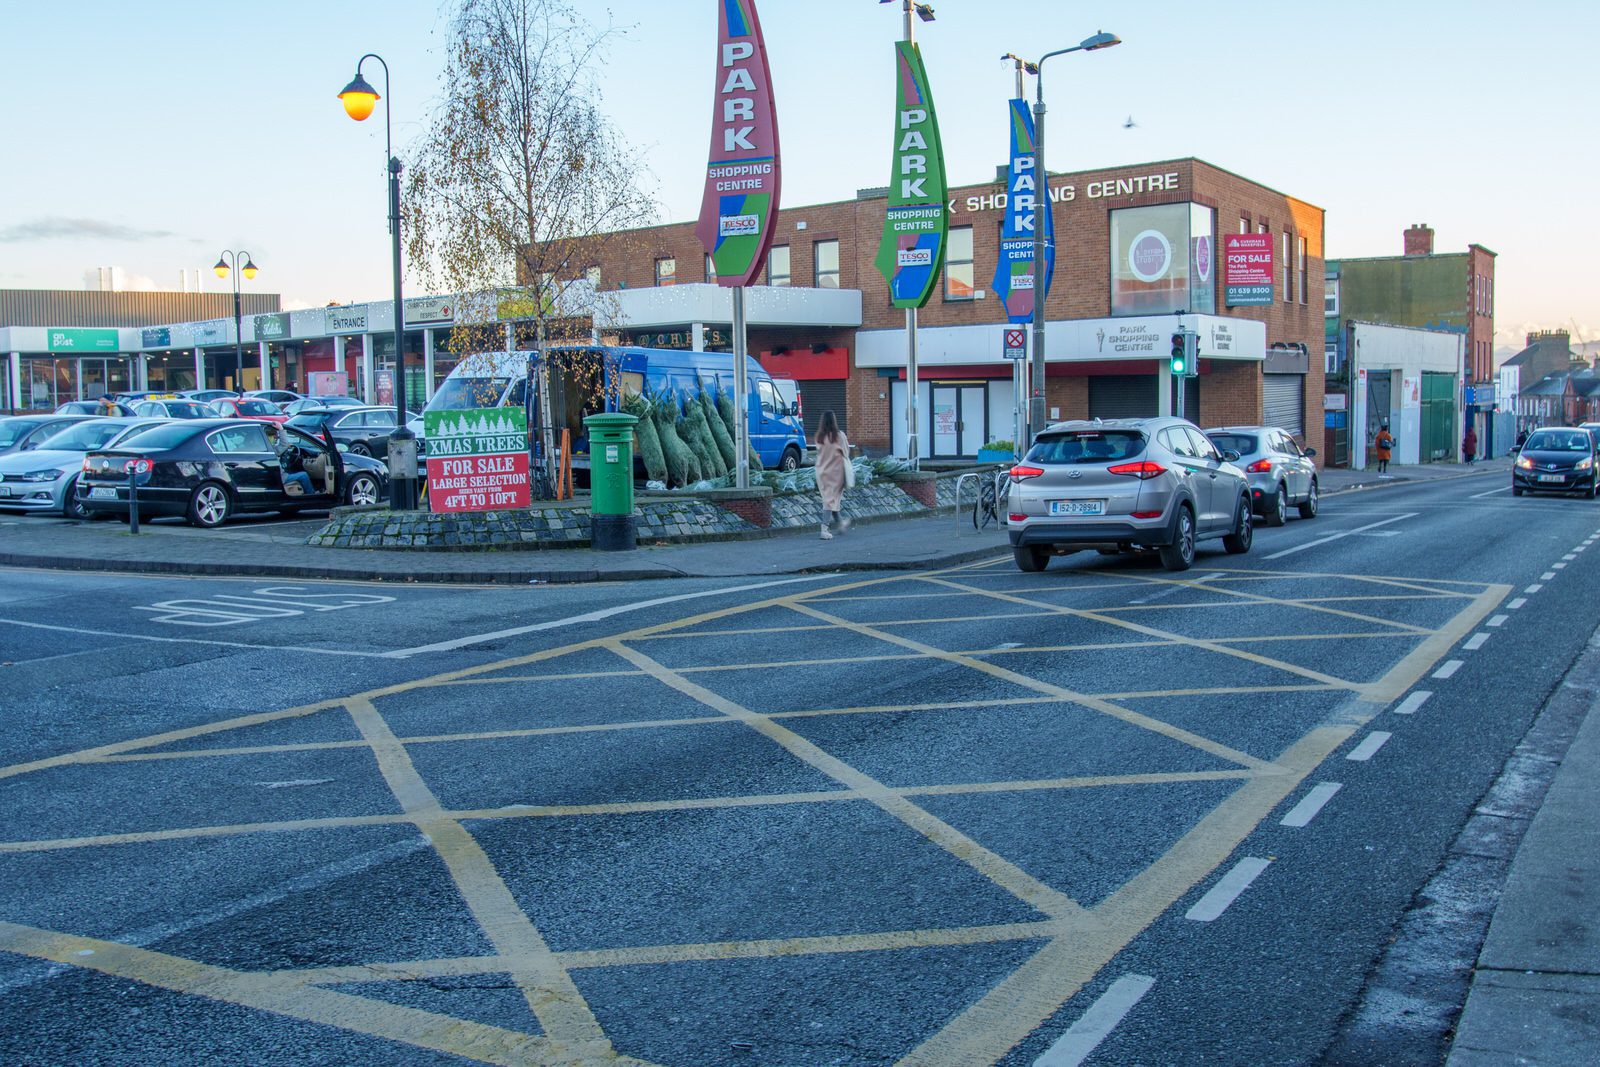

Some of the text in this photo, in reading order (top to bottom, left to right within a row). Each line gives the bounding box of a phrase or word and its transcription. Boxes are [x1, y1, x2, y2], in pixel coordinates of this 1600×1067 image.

[721, 41, 758, 152] PARK
[898, 109, 928, 199] PARK
[709, 164, 772, 179] SHOPPING
[716, 179, 762, 192] CENTRE
[966, 185, 1076, 211] SHONG
[1086, 172, 1178, 199] CENTRE
[887, 208, 940, 220] SHOPPING
[723, 219, 756, 228] TESCO
[894, 220, 934, 231] CENTRE
[901, 252, 929, 260] TESCO
[1008, 250, 1035, 259] CENT
[1228, 254, 1271, 263] FOR SALE
[333, 317, 365, 330] ENTRANCE
[1120, 325, 1147, 334] PARK
[53, 338, 74, 347] post
[1109, 333, 1160, 343] SHOPPING
[1114, 342, 1153, 352] CENTRE
[429, 435, 525, 455] XMAS TREES
[442, 459, 475, 476] FOR
[477, 457, 514, 474] SALE
[432, 473, 526, 490] LARGE SELECTION
[445, 492, 517, 508] 4FT TO 10FT
